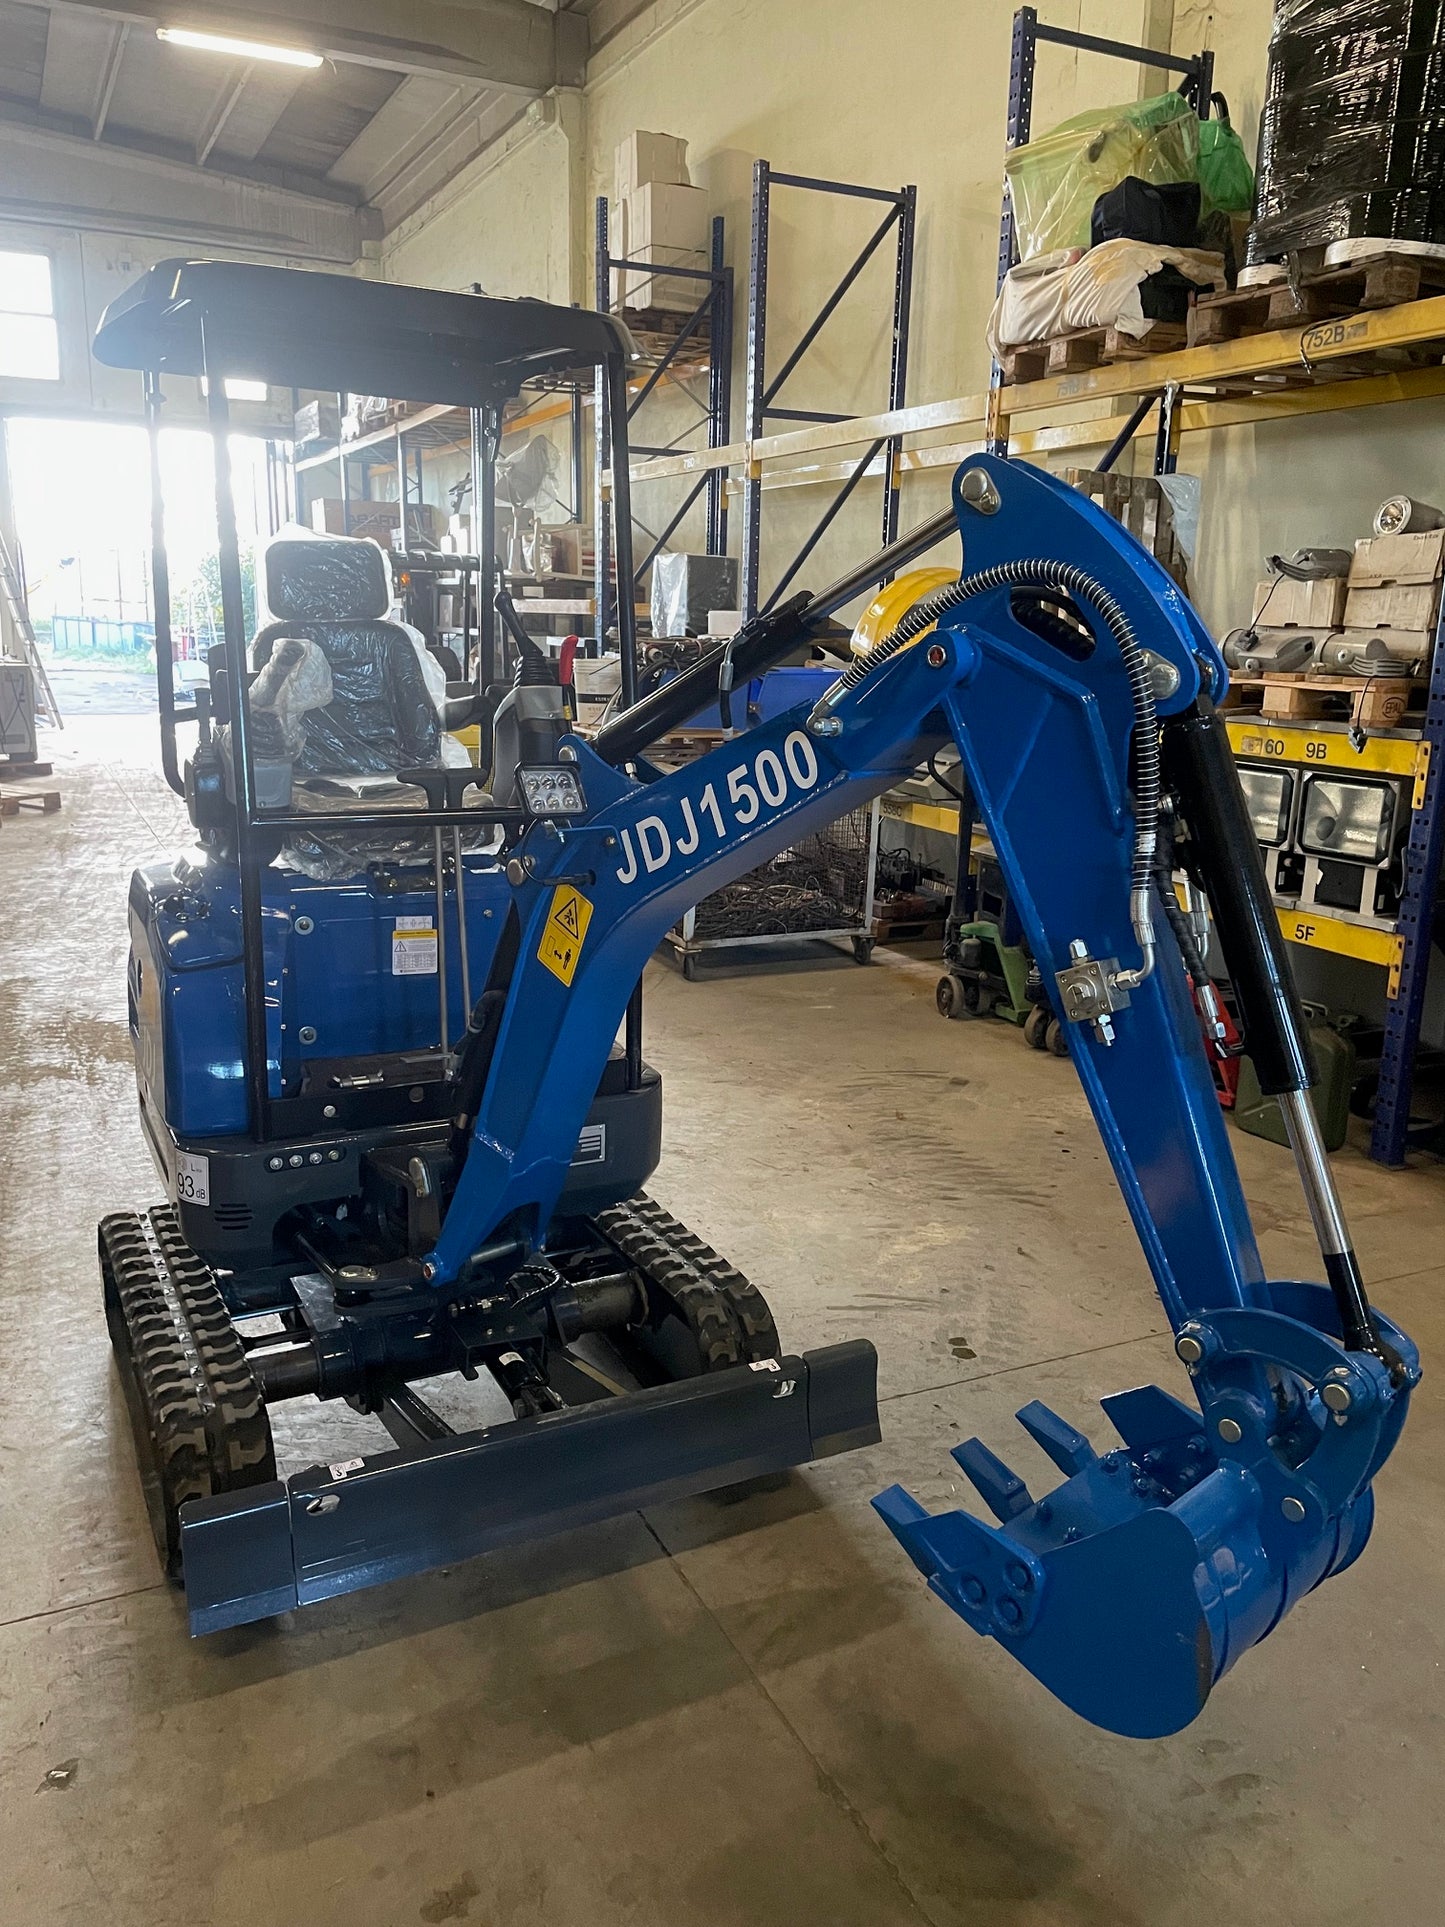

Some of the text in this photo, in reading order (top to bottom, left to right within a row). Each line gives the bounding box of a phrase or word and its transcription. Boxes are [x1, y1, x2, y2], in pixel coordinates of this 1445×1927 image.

[1306, 325, 1345, 349] 752B
[1264, 739, 1285, 756] 60
[1305, 742, 1328, 760] 9B
[616, 730, 818, 884] JDJ1500
[1295, 924, 1316, 941] 5F
[177, 1172, 206, 1199] 93 dB
